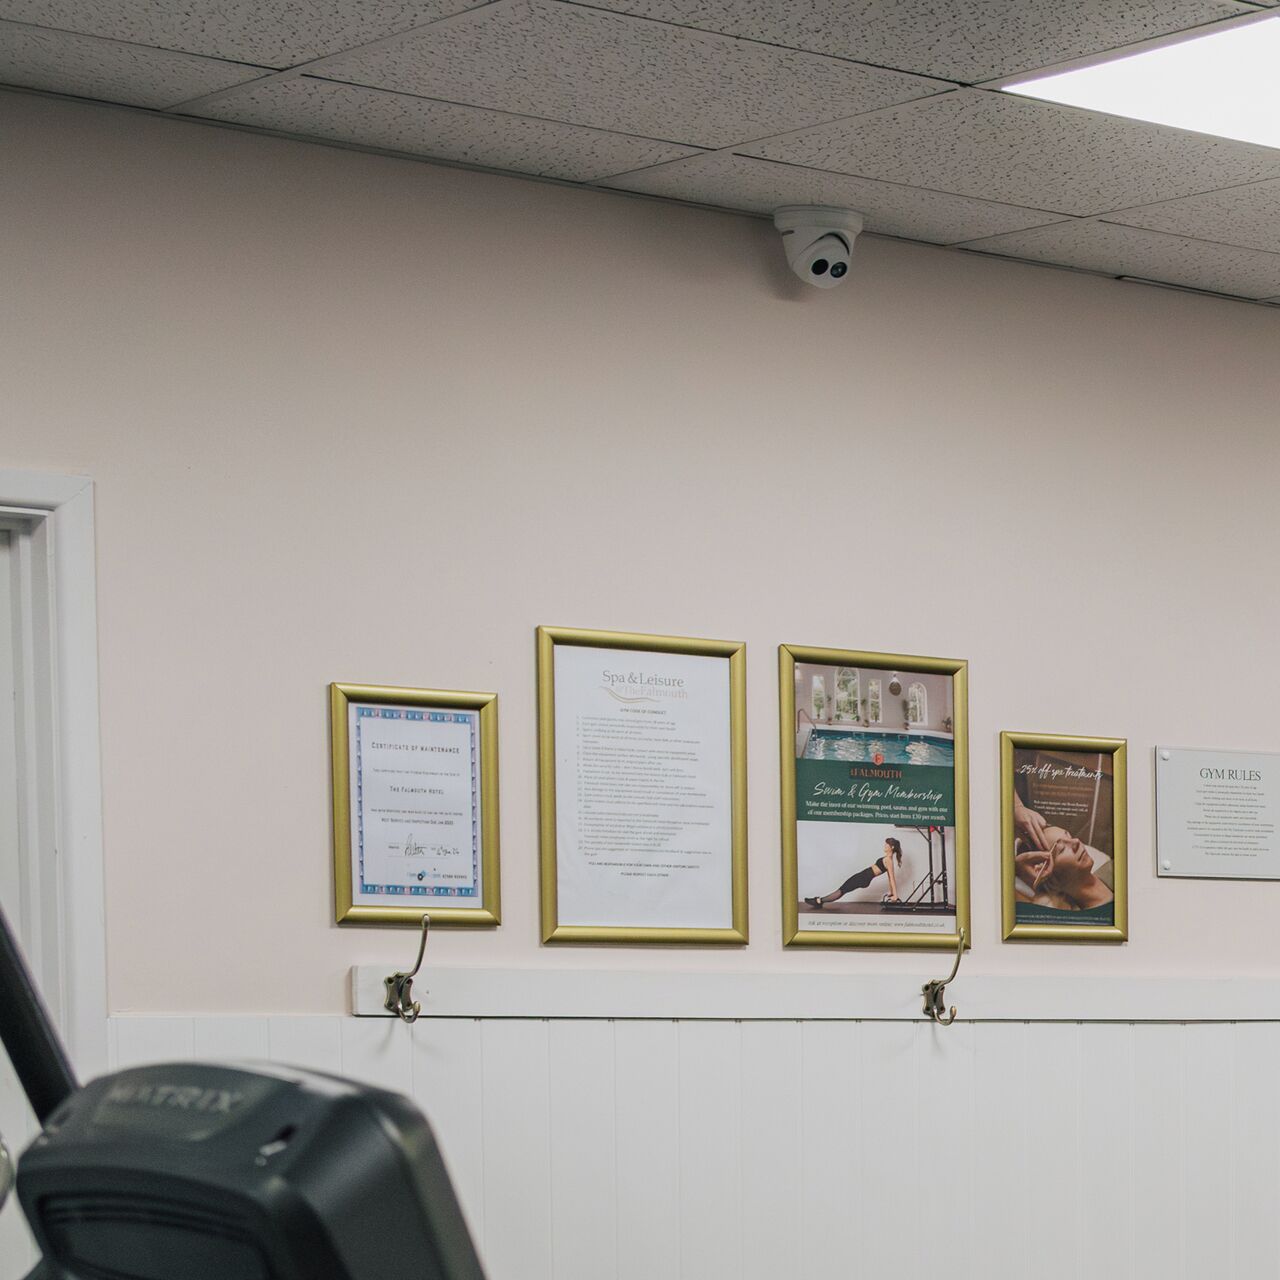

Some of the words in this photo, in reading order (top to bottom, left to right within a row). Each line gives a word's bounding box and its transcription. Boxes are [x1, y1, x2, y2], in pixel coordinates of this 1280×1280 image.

[602, 670, 625, 686] Spa
[628, 672, 638, 684] &
[639, 673, 685, 687] Leisure
[1020, 764, 1037, 774] 25%
[1038, 763, 1051, 779] off
[1051, 769, 1065, 780] spa
[1065, 765, 1104, 780] treatments
[1199, 768, 1225, 780] GYM
[1228, 769, 1262, 781] RULES
[813, 781, 844, 796] Swim
[847, 784, 858, 798] &
[858, 783, 883, 802] Gym
[885, 784, 943, 805] Membership
